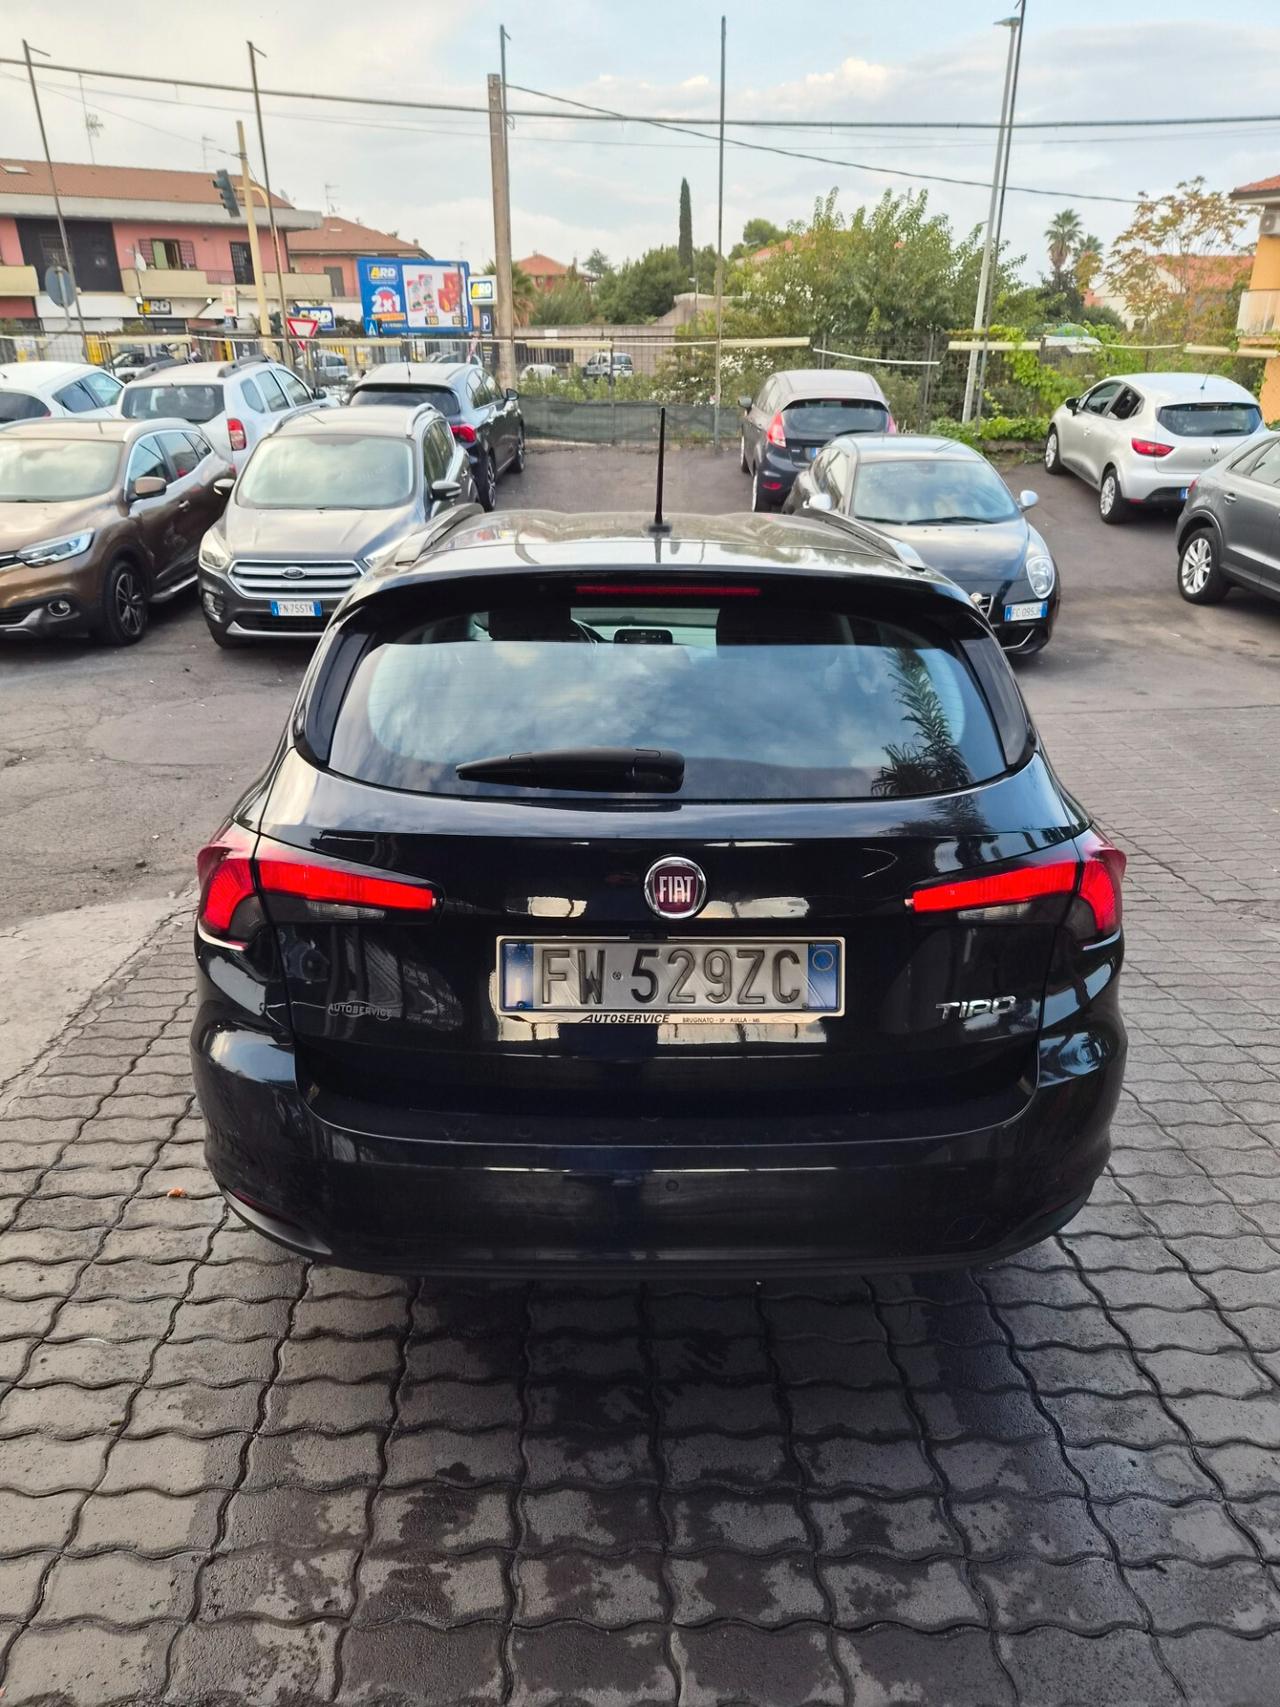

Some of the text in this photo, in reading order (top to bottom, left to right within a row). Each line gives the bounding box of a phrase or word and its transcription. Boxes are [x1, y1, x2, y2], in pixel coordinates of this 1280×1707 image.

[371, 267, 396, 279] ARD
[471, 282, 492, 298] ARD
[140, 300, 170, 313] ARD
[659, 876, 694, 903] FIAT
[541, 949, 801, 1004] FW 529ZC
[936, 995, 1016, 1019] TIPO
[579, 1014, 670, 1024] AUTOSERVICE
